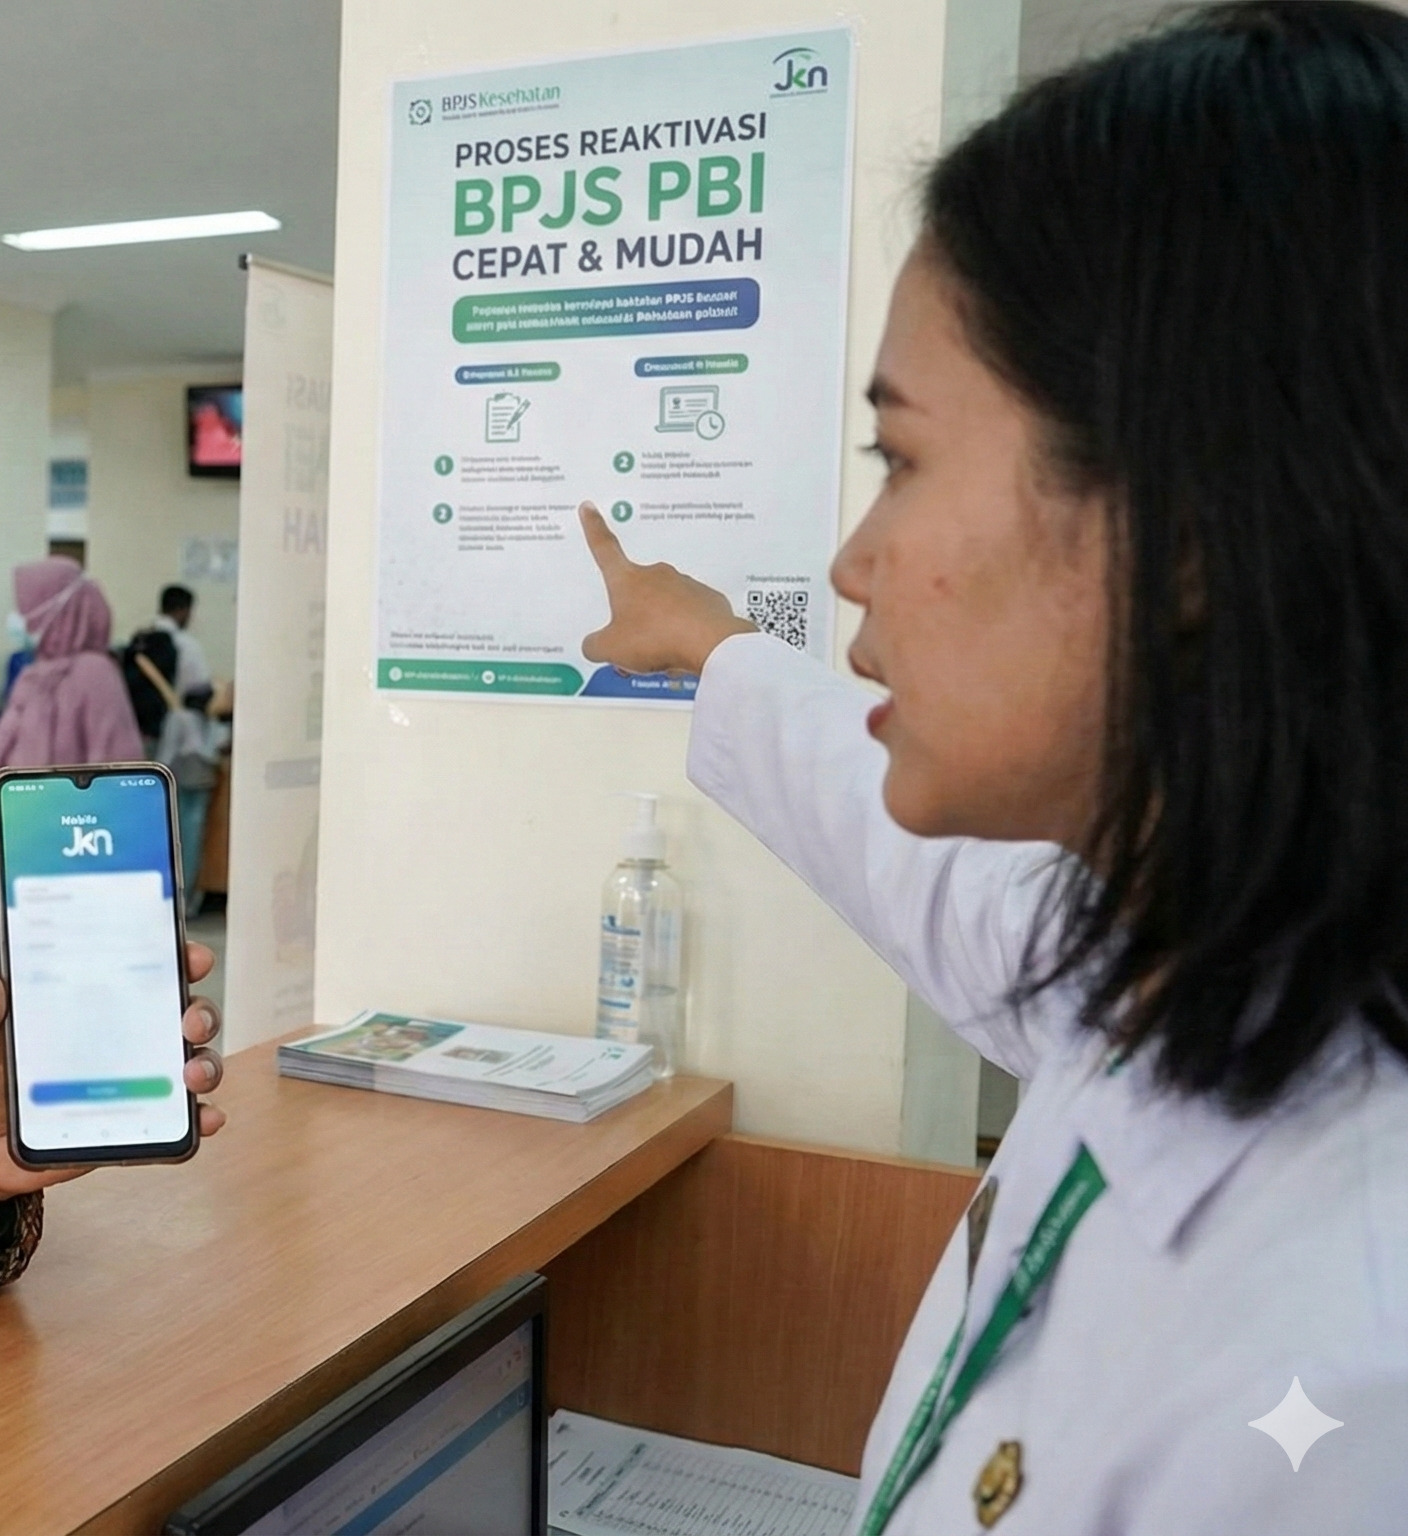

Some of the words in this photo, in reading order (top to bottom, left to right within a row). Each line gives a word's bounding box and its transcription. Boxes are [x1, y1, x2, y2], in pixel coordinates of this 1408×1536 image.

[442, 93, 477, 112] BPJS
[479, 86, 561, 108] Kesehatan
[455, 132, 570, 168] PROSES
[579, 112, 767, 157] REAKTIVASI
[454, 165, 623, 237] BPJS
[648, 151, 765, 222] PBI
[452, 242, 568, 281] CEPAT
[578, 240, 603, 273] &
[616, 227, 763, 271] MUDAH
